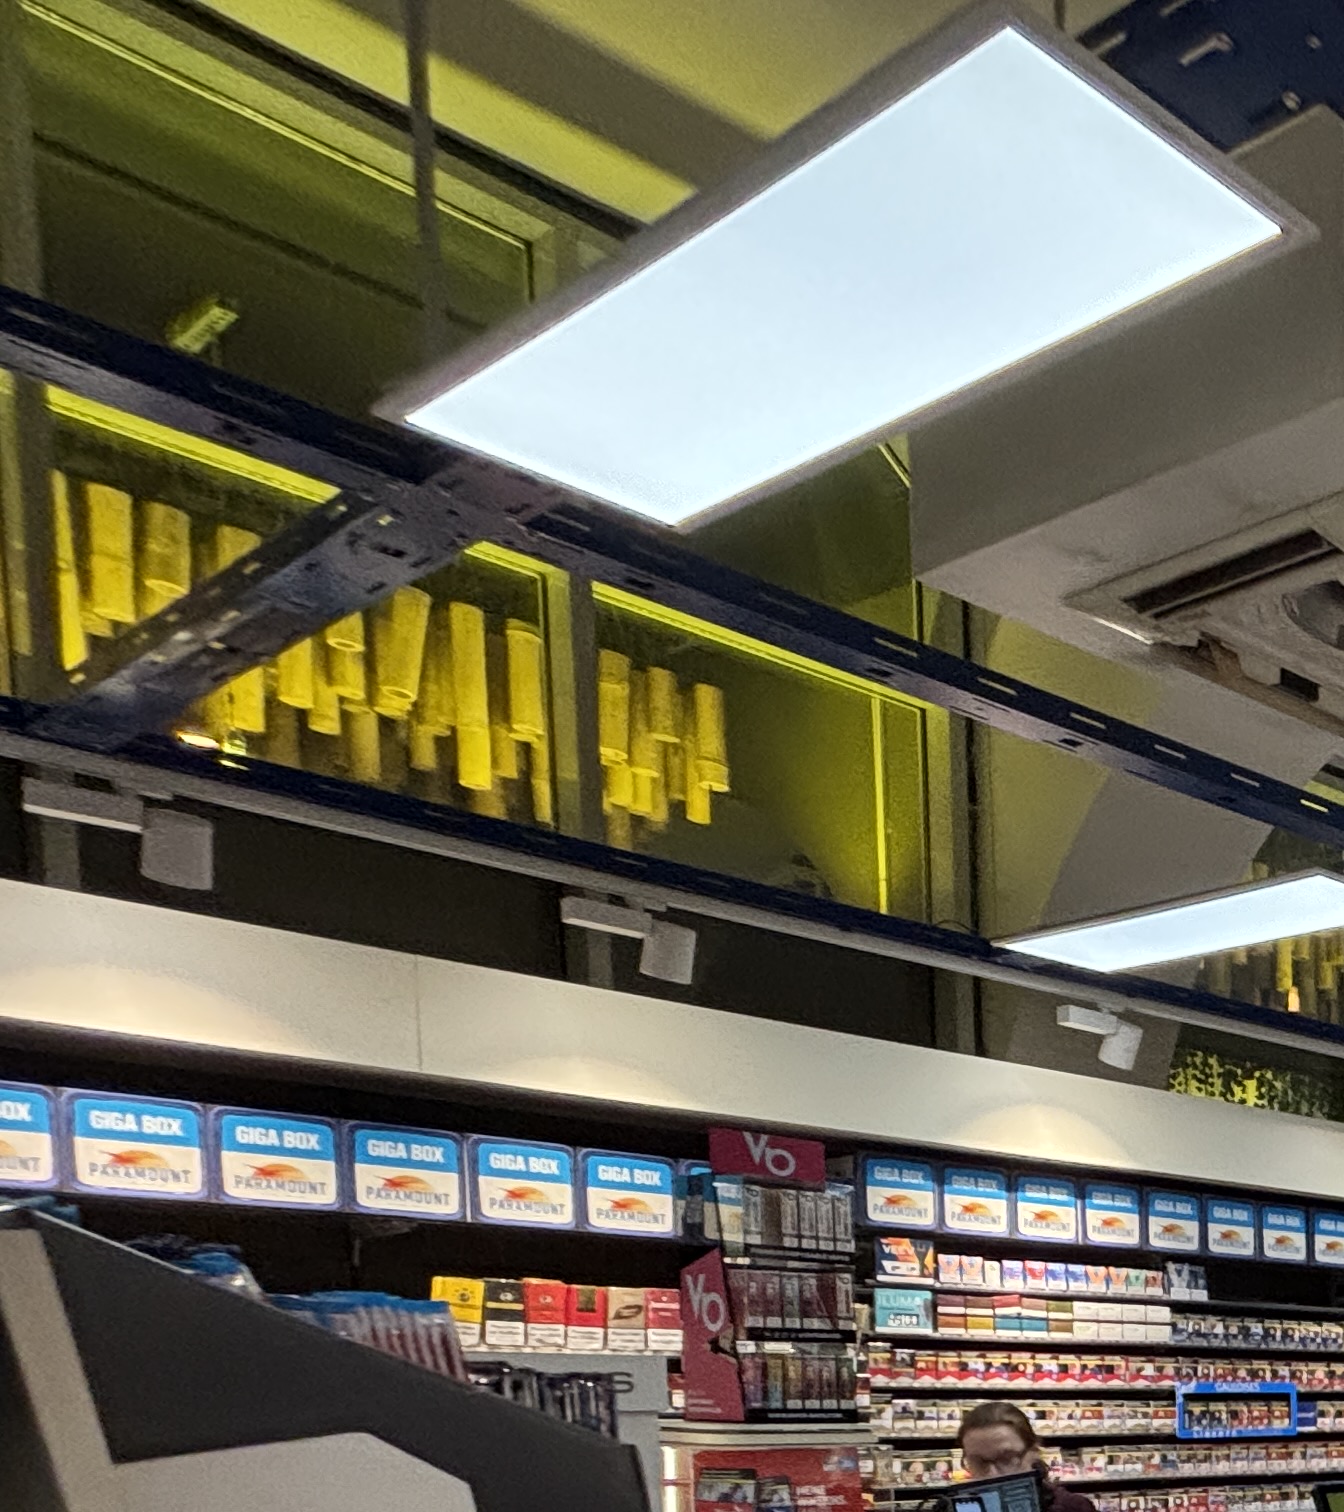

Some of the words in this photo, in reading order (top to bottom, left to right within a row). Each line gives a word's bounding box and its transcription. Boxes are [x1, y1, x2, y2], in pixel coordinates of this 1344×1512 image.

[89, 1110, 139, 1132] GIGA
[142, 1115, 183, 1136] BOX
[235, 1126, 279, 1147] GIGA
[283, 1130, 320, 1150] BOX
[367, 1139, 408, 1159] GIGA
[410, 1143, 445, 1163] BOX
[89, 1163, 191, 1185] PARAMOUNT
[489, 1152, 527, 1173] GIGA
[529, 1156, 560, 1175] BOX
[234, 1174, 326, 1195] PARAMOUNT
[598, 1165, 631, 1182] GIGA
[634, 1169, 662, 1186] BOX
[874, 1166, 901, 1182] GIGA
[902, 1169, 924, 1183] BOX
[366, 1186, 450, 1206] PARAMOUNT
[489, 1197, 565, 1216] PARAMOUNT
[596, 1208, 665, 1225] PARAMOUNT
